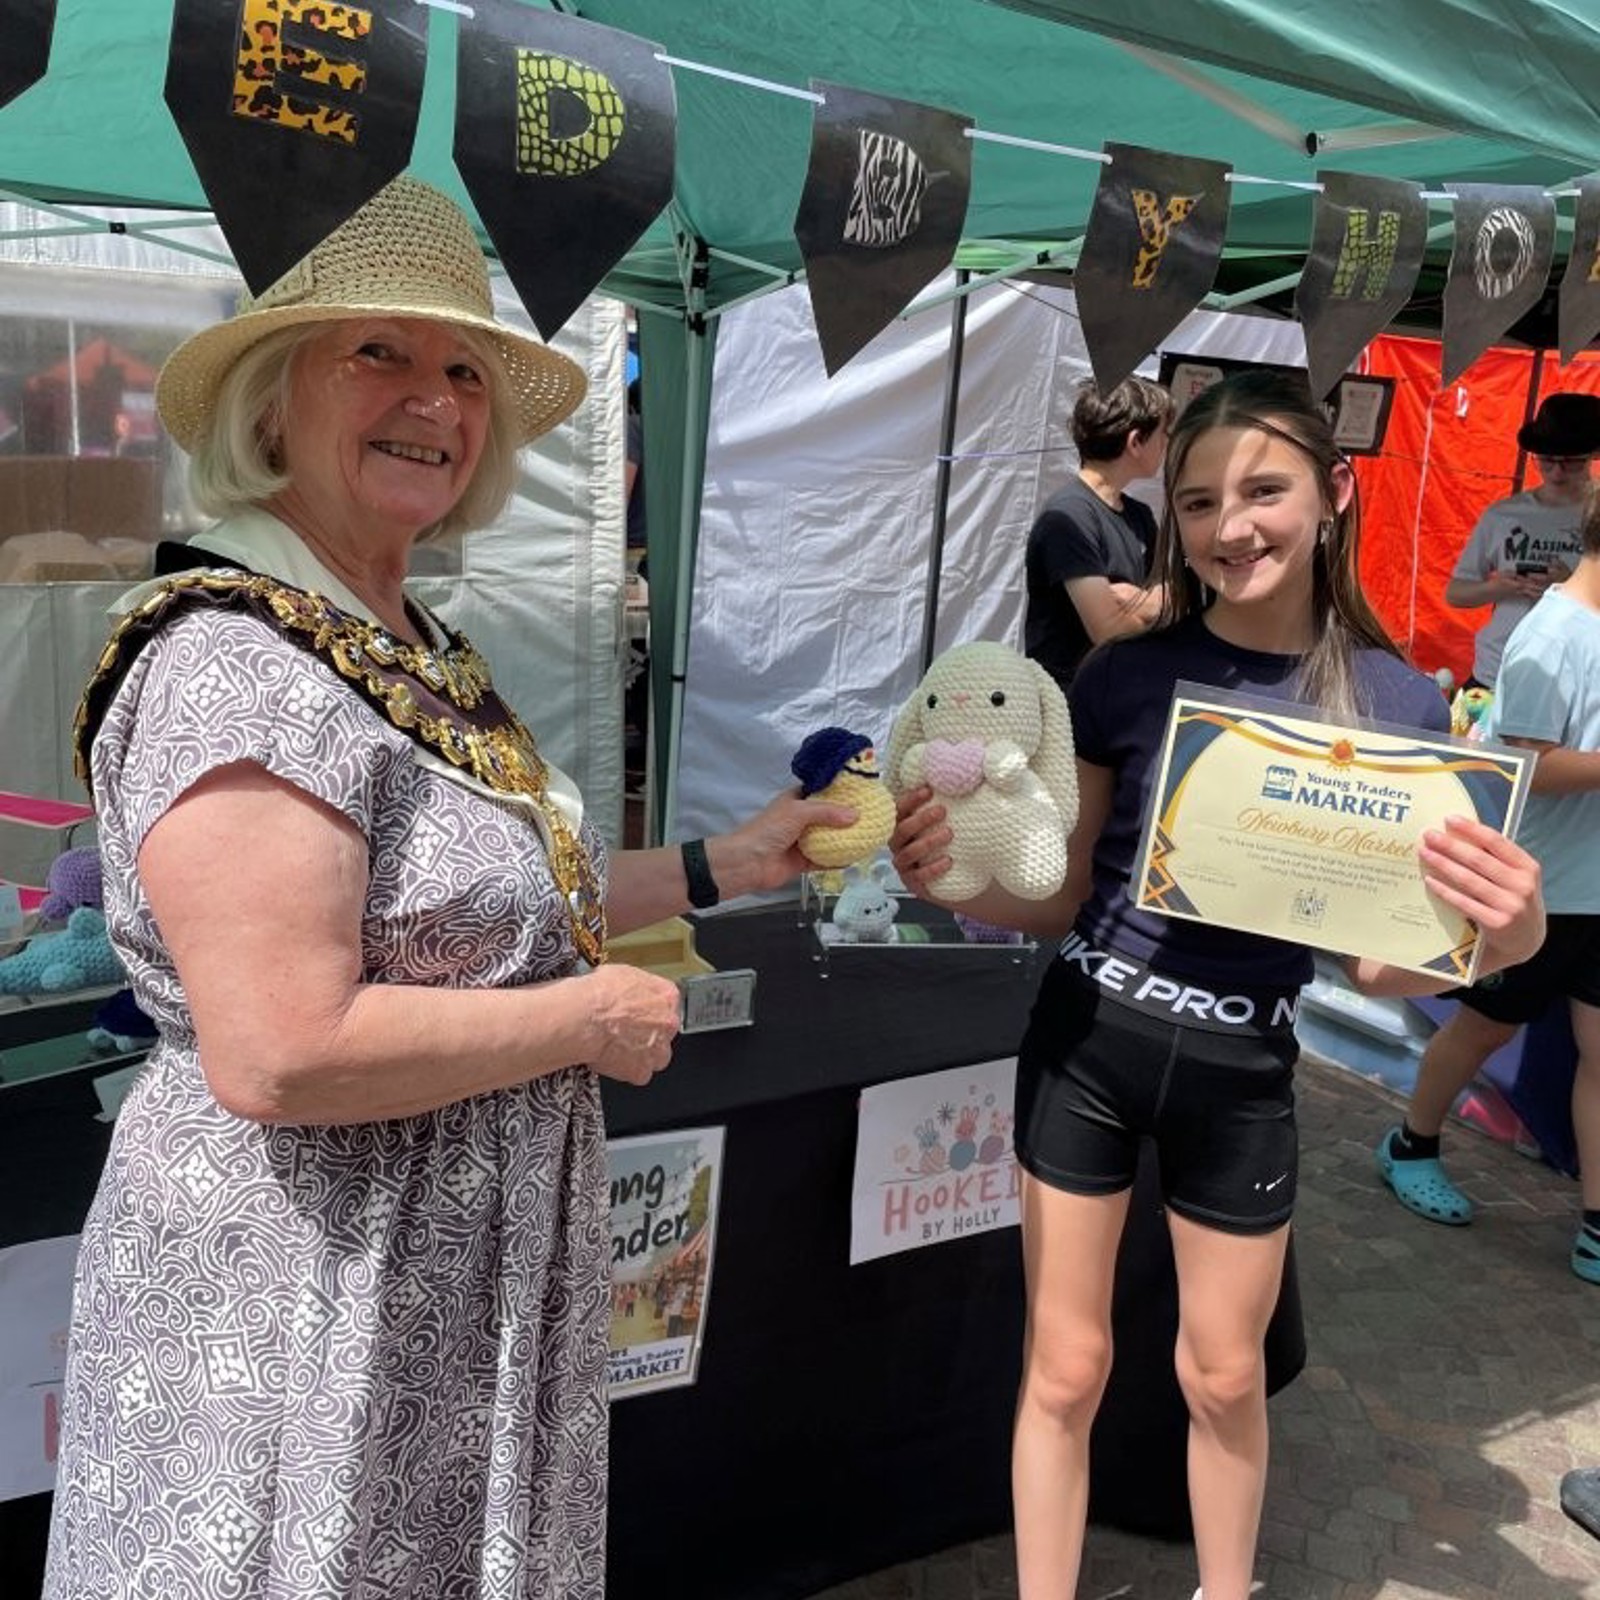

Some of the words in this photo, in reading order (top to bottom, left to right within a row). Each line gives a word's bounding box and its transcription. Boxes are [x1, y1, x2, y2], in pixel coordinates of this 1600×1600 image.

[232, 0, 372, 146] E
[516, 48, 625, 177] D
[842, 128, 928, 248] B
[1131, 187, 1198, 289] Y
[1331, 208, 1400, 301] H
[1475, 207, 1535, 300] O
[1237, 808, 1330, 844] Newbury
[1333, 826, 1414, 857] Market
[1296, 787, 1410, 823] MARKET
[1307, 772, 1350, 792] Young
[1356, 781, 1411, 800] Traders
[1060, 930, 1139, 991] IKE
[1134, 975, 1255, 1024] PRO
[922, 1220, 944, 1238] BY
[953, 1208, 1000, 1234] HOLLY
[606, 1357, 684, 1384] MARKET
